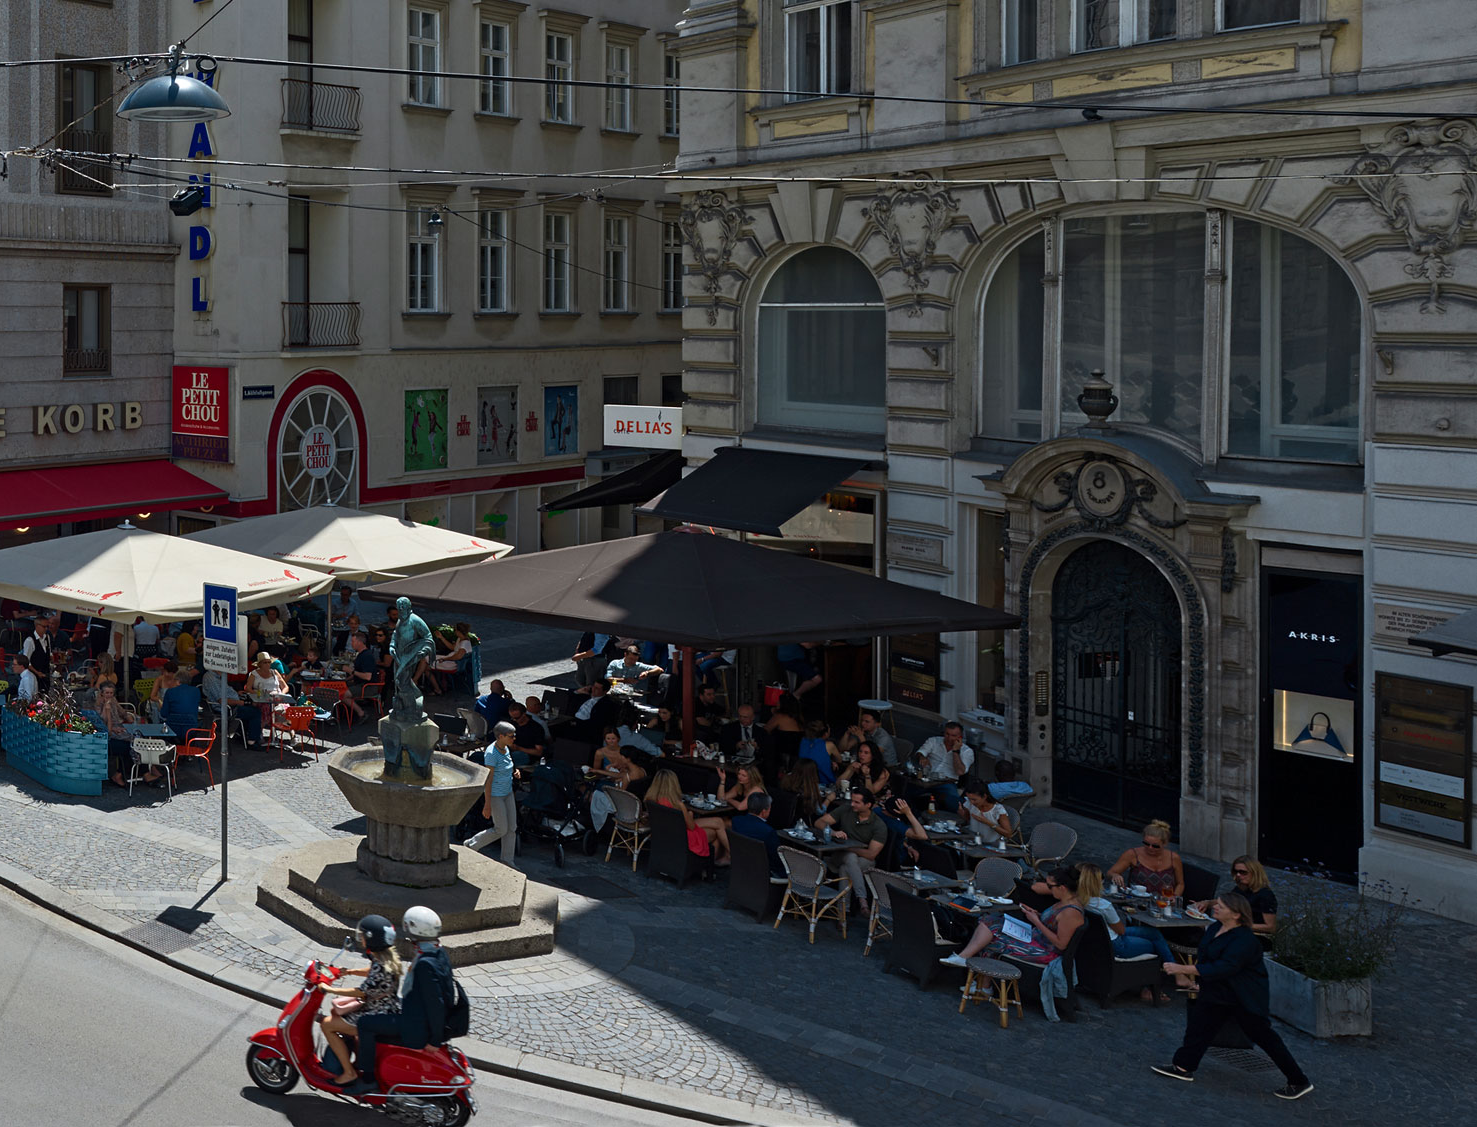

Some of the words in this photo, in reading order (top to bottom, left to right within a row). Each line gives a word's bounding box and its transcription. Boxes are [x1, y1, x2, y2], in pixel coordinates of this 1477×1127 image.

[192, 372, 209, 389] LE
[181, 388, 220, 405] PETIT
[36, 401, 143, 435] KORB
[181, 404, 221, 422] CHOU
[616, 419, 673, 435] DELIA'S
[313, 432, 324, 444] LE
[306, 444, 331, 457] PETIT
[306, 456, 331, 469] CHOU
[1093, 472, 1106, 489] 8
